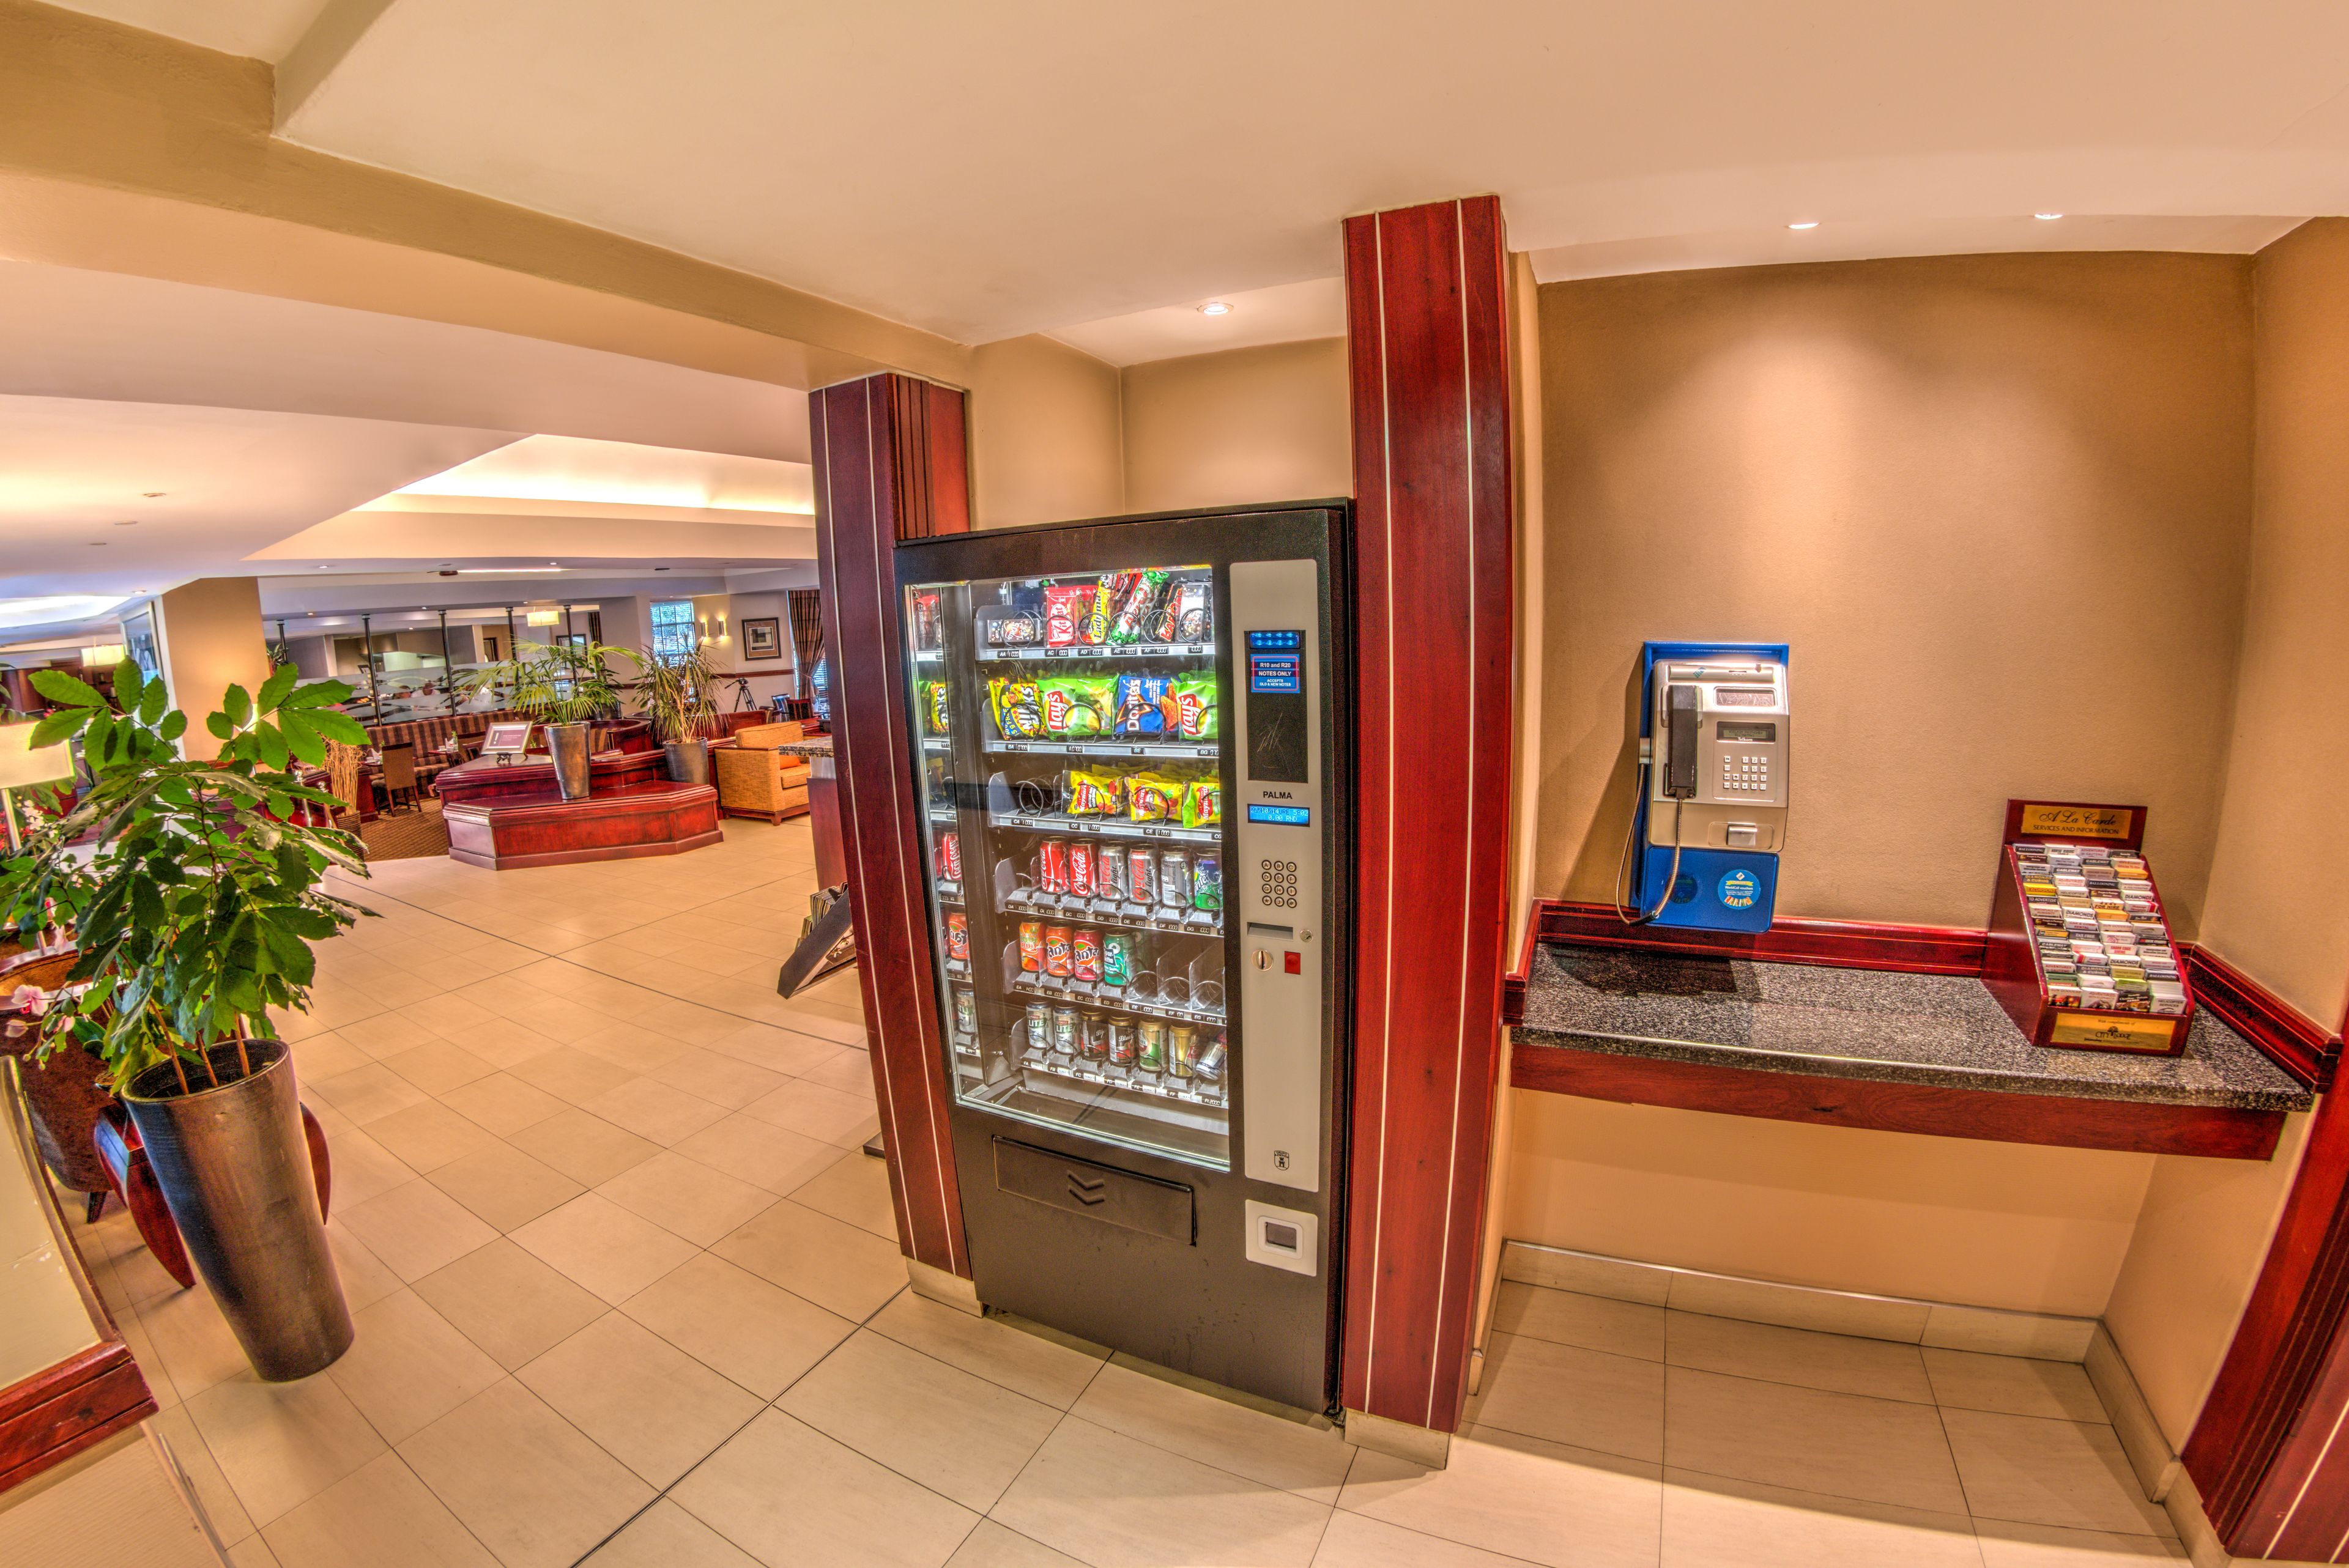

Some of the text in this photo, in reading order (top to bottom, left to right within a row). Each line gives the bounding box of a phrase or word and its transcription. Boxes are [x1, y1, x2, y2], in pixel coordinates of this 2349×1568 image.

[1263, 791, 1293, 799] PALMA
[2039, 810, 2117, 826] A La Carde
